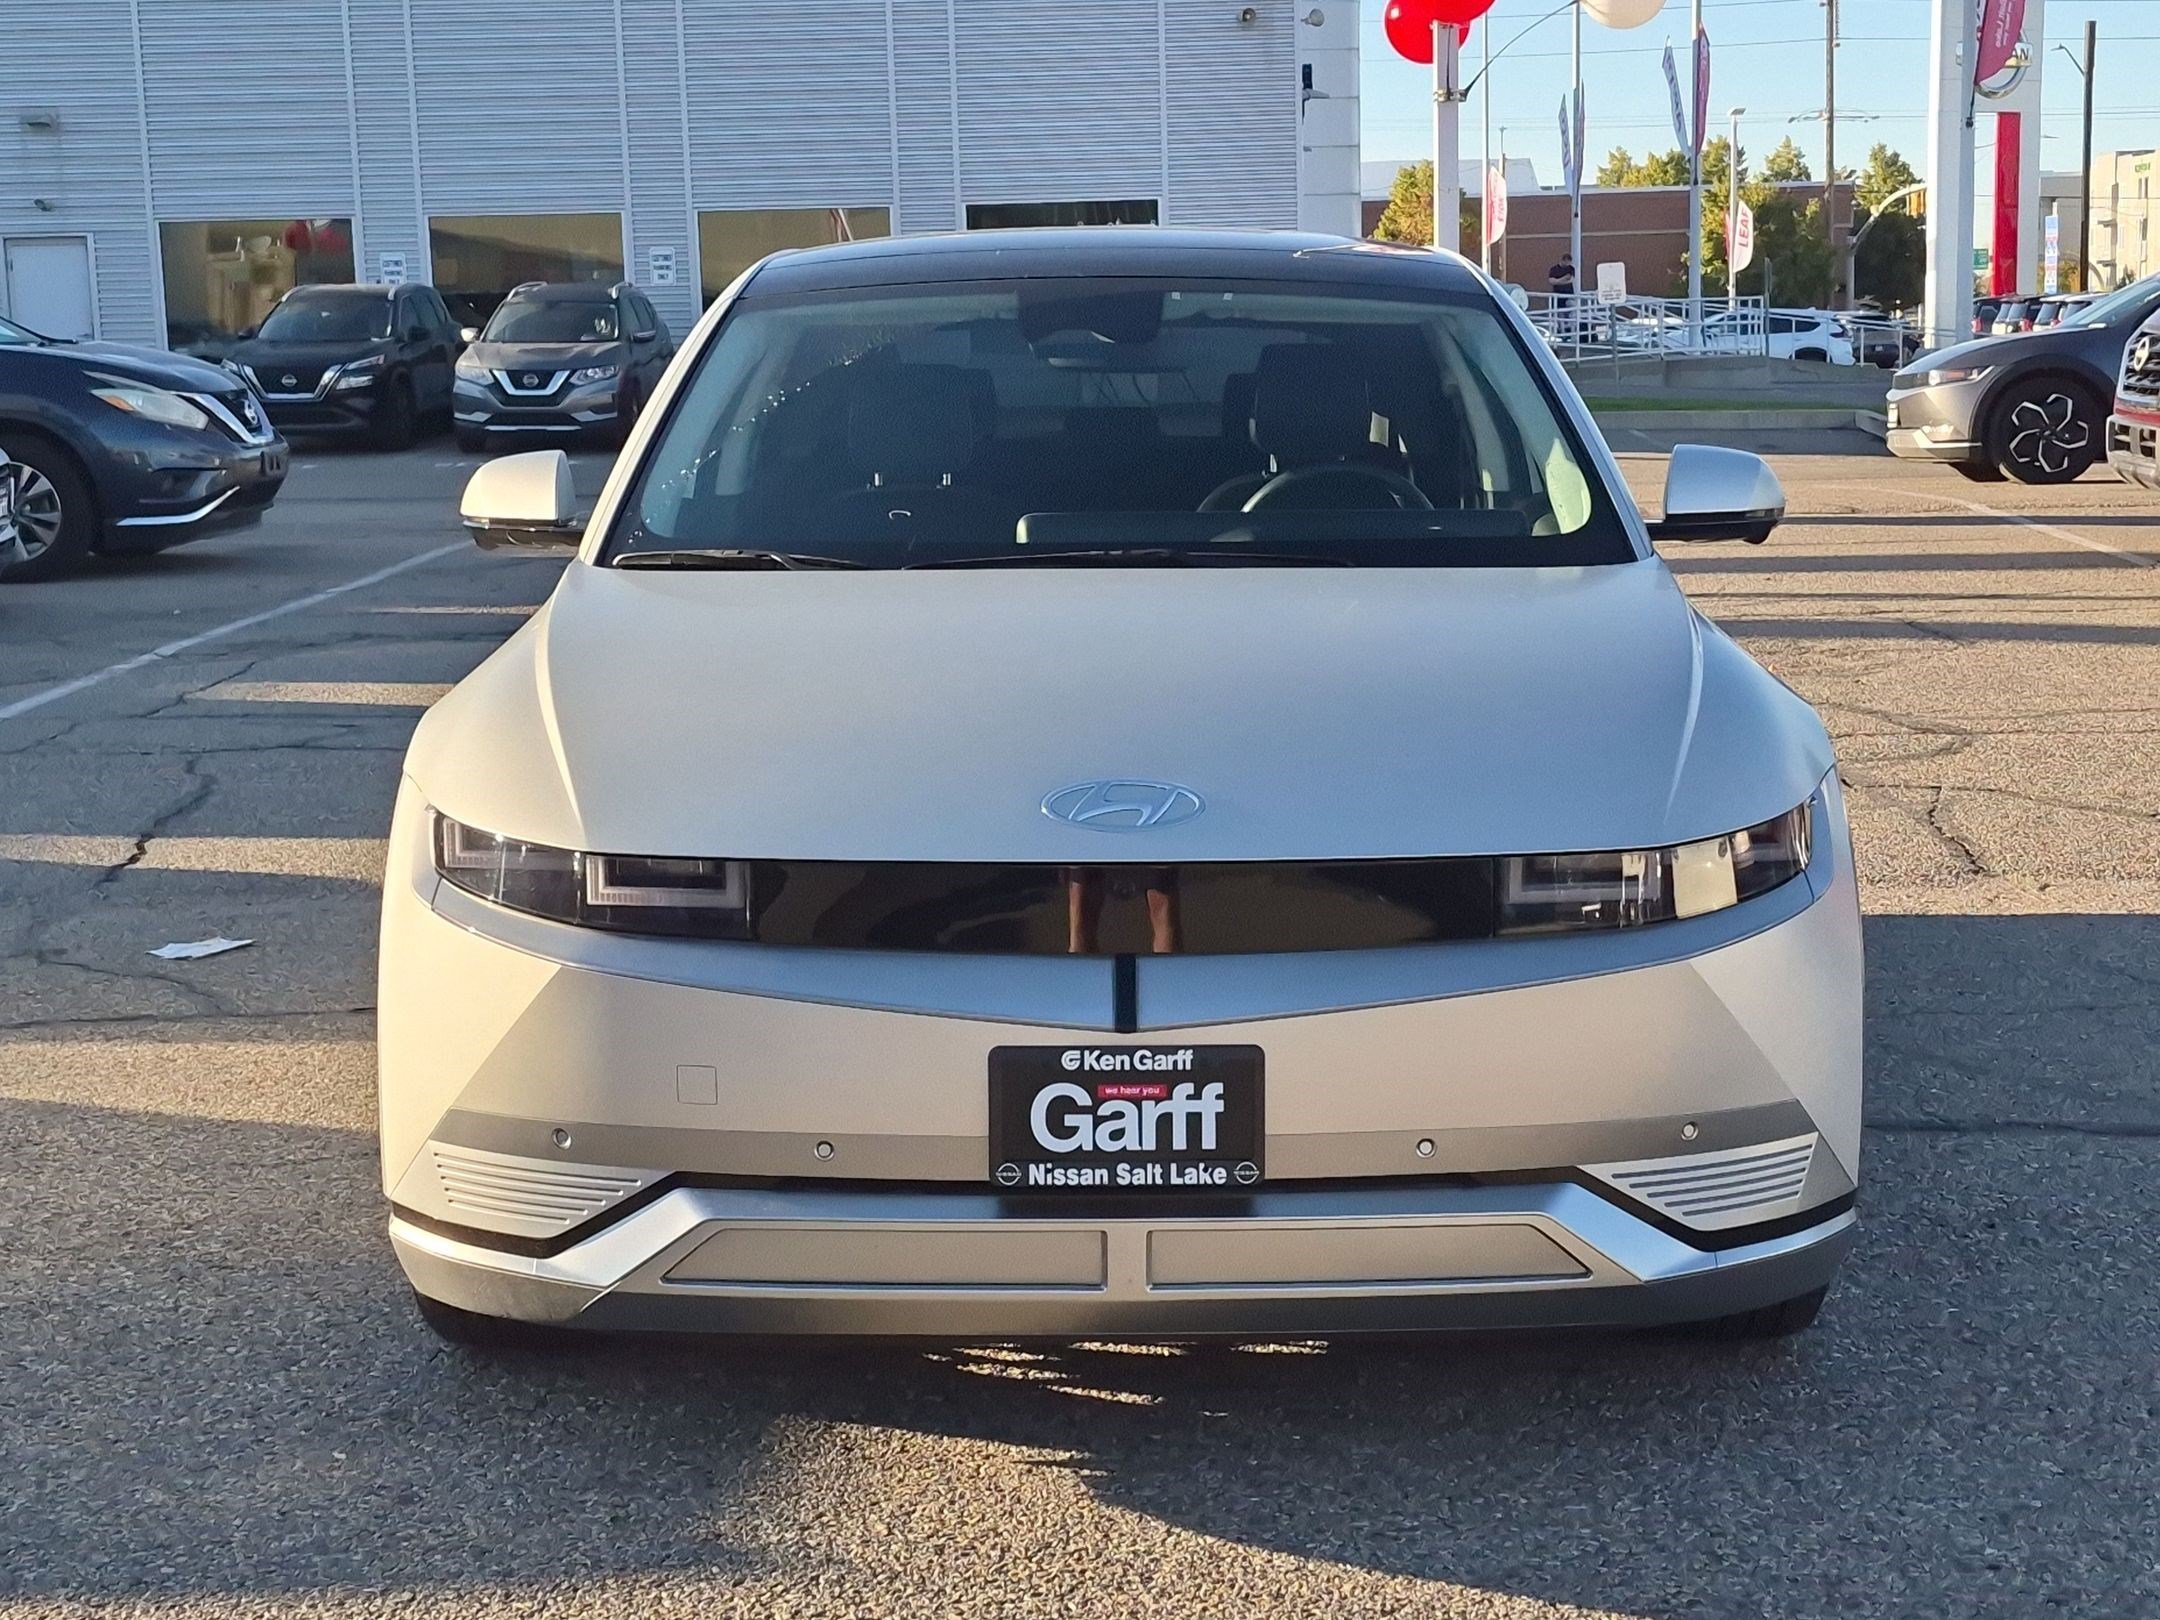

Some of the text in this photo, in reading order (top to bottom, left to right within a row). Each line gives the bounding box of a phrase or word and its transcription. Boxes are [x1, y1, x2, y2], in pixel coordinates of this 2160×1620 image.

[1084, 1050, 1130, 1071] Ken
[1133, 1049, 1193, 1071] Garff
[1120, 1085, 1140, 1095] hear
[1143, 1087, 1160, 1096] you
[1030, 1082, 1224, 1153] Garff
[1028, 1162, 1228, 1186] Nissan Salt Lake
